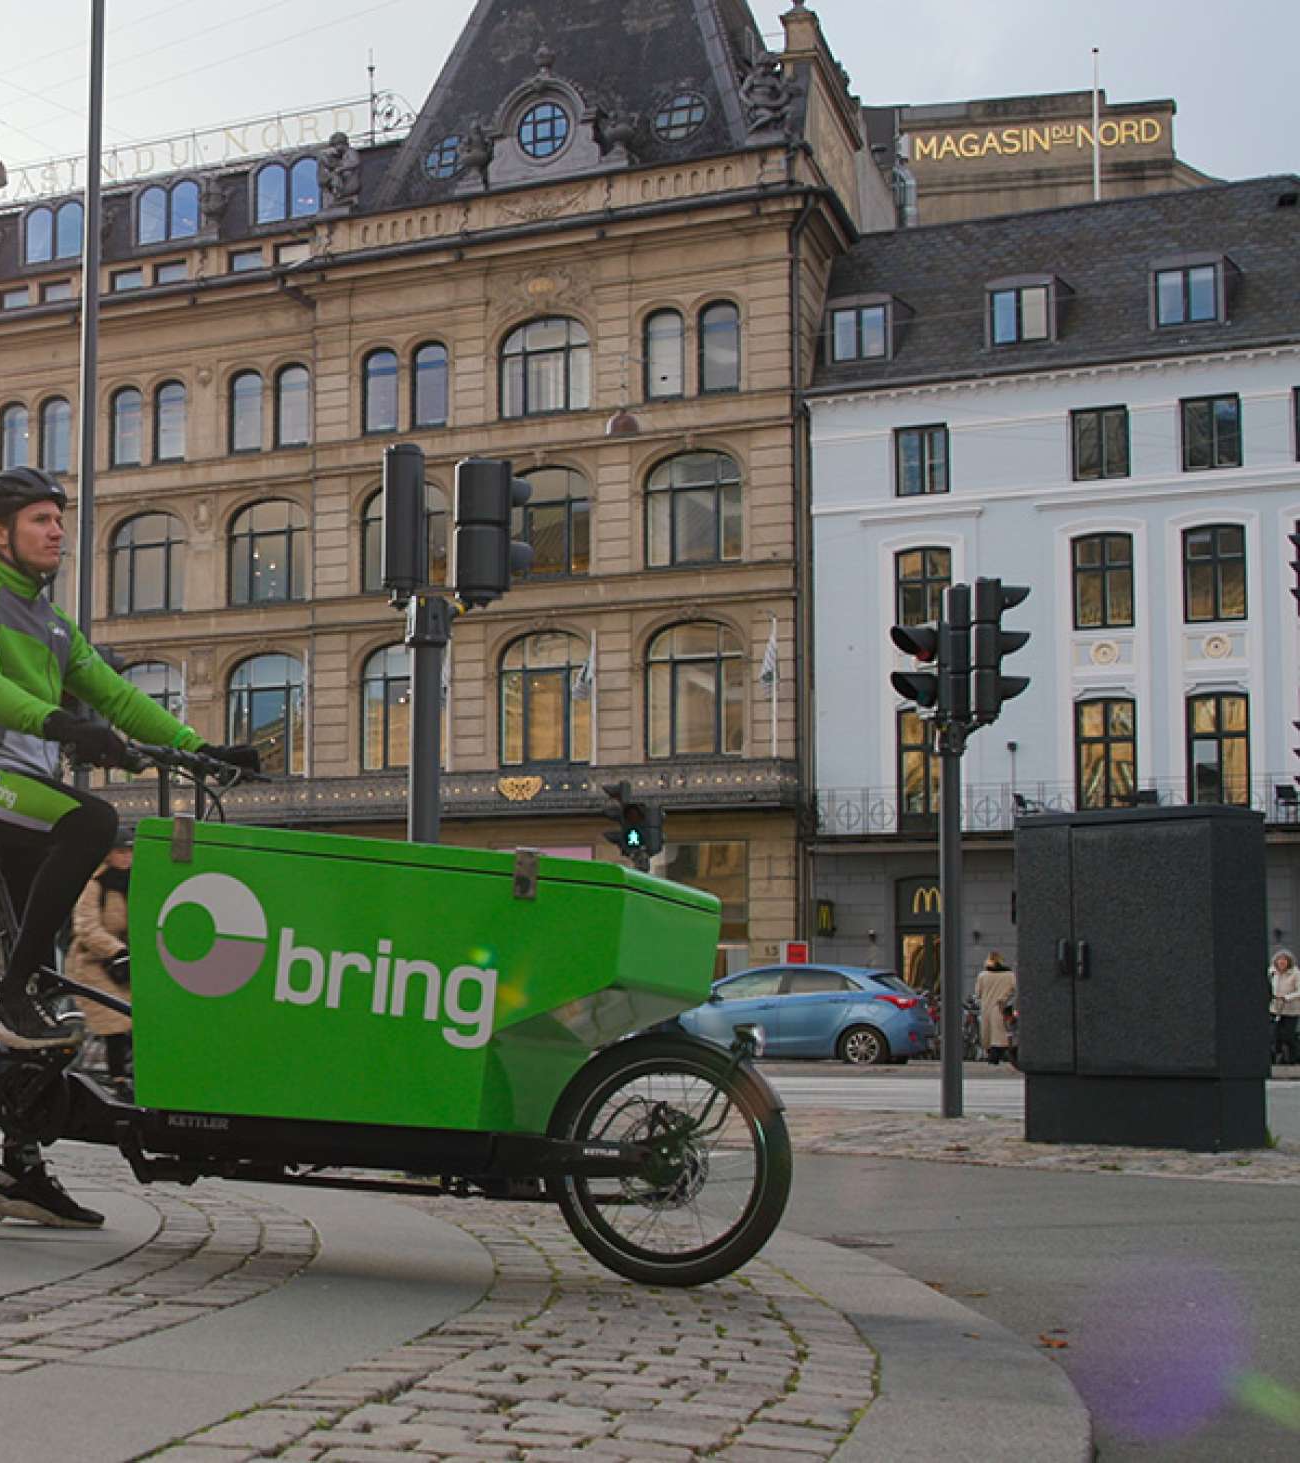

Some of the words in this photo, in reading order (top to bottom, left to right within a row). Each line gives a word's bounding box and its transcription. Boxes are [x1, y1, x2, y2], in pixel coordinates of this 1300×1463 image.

[914, 127, 1050, 161] MAGASIN
[1052, 125, 1074, 138] DU
[1076, 118, 1162, 150] NORD
[274, 927, 498, 1050] bring
[168, 1113, 229, 1130] KETTLER
